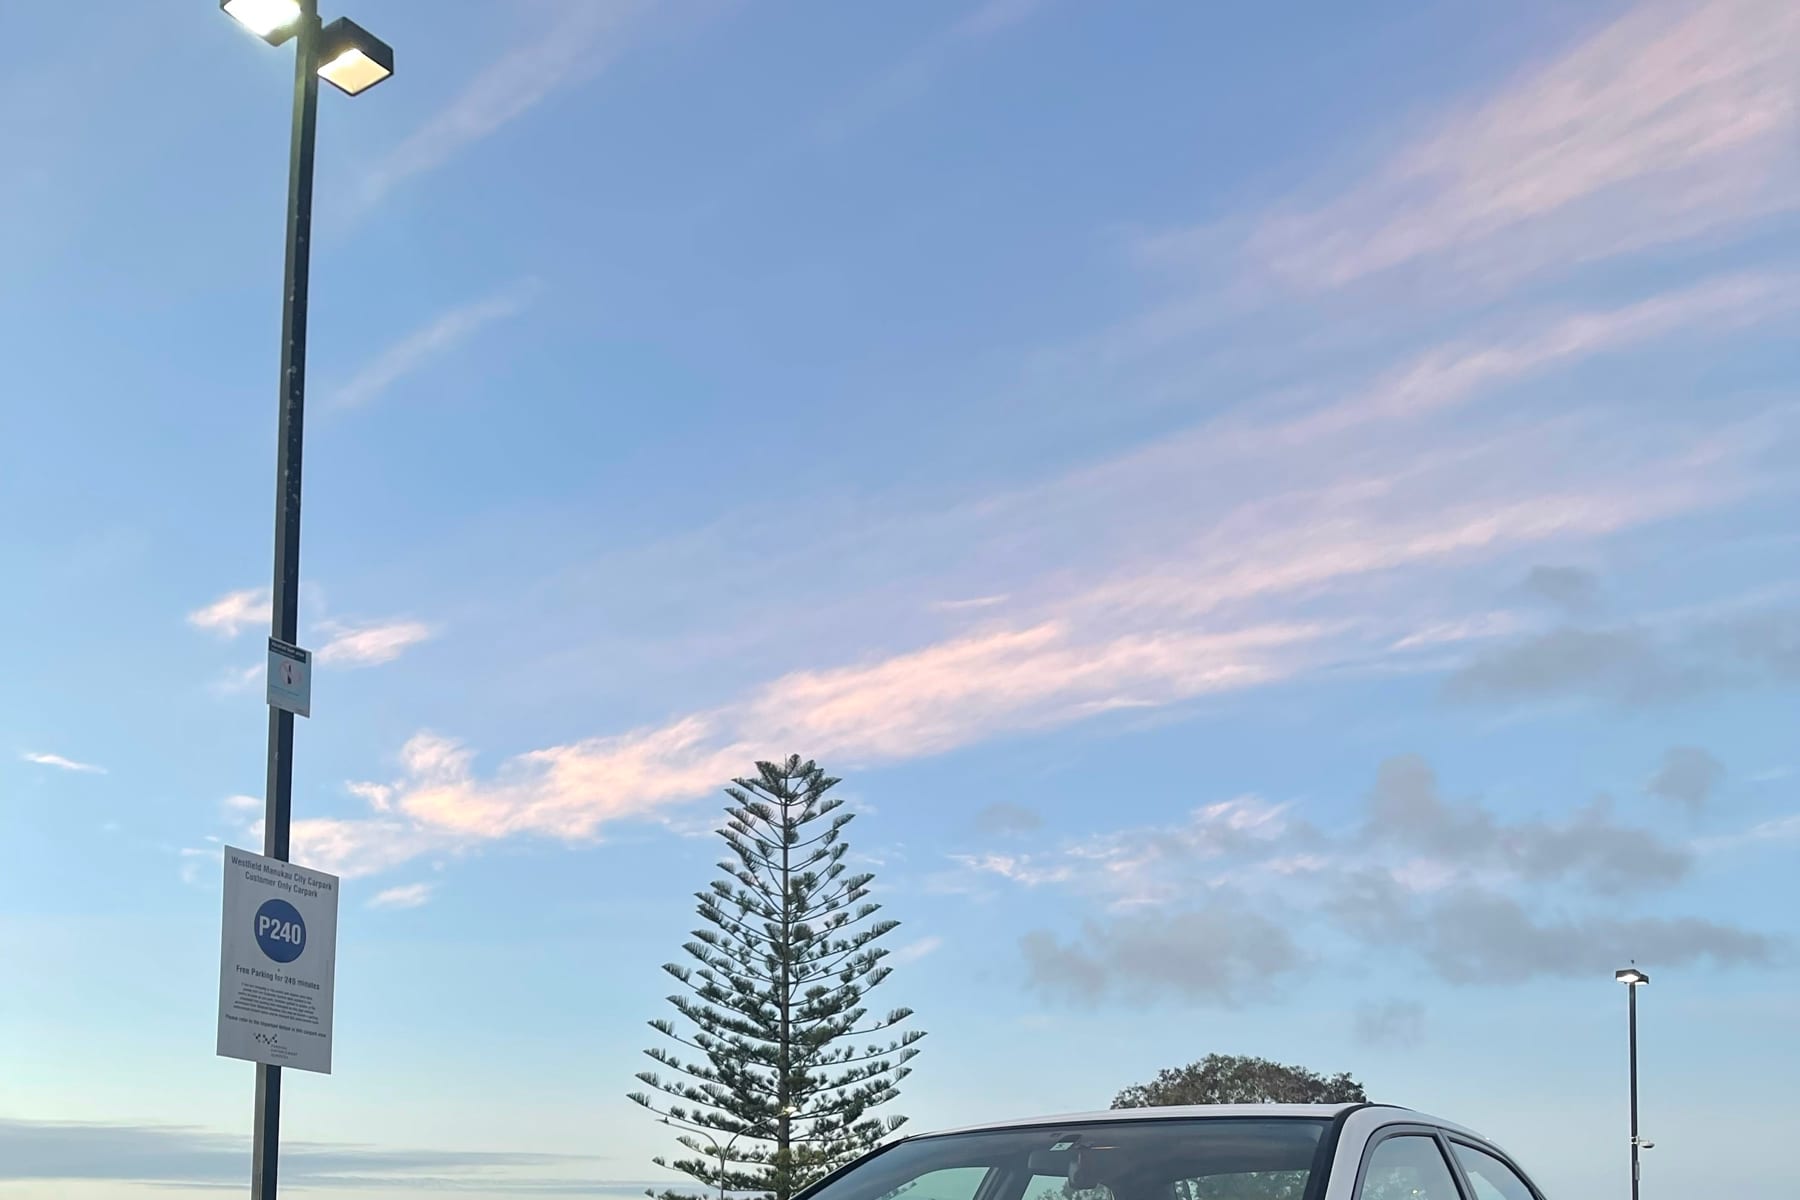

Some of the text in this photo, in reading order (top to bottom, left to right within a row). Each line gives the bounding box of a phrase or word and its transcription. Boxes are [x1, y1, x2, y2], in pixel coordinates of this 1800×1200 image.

[231, 856, 332, 890] Westfield Manukau City Carpark
[245, 871, 318, 897] Customer Only Carpark
[258, 915, 301, 945] P240
[251, 967, 273, 981] Parking
